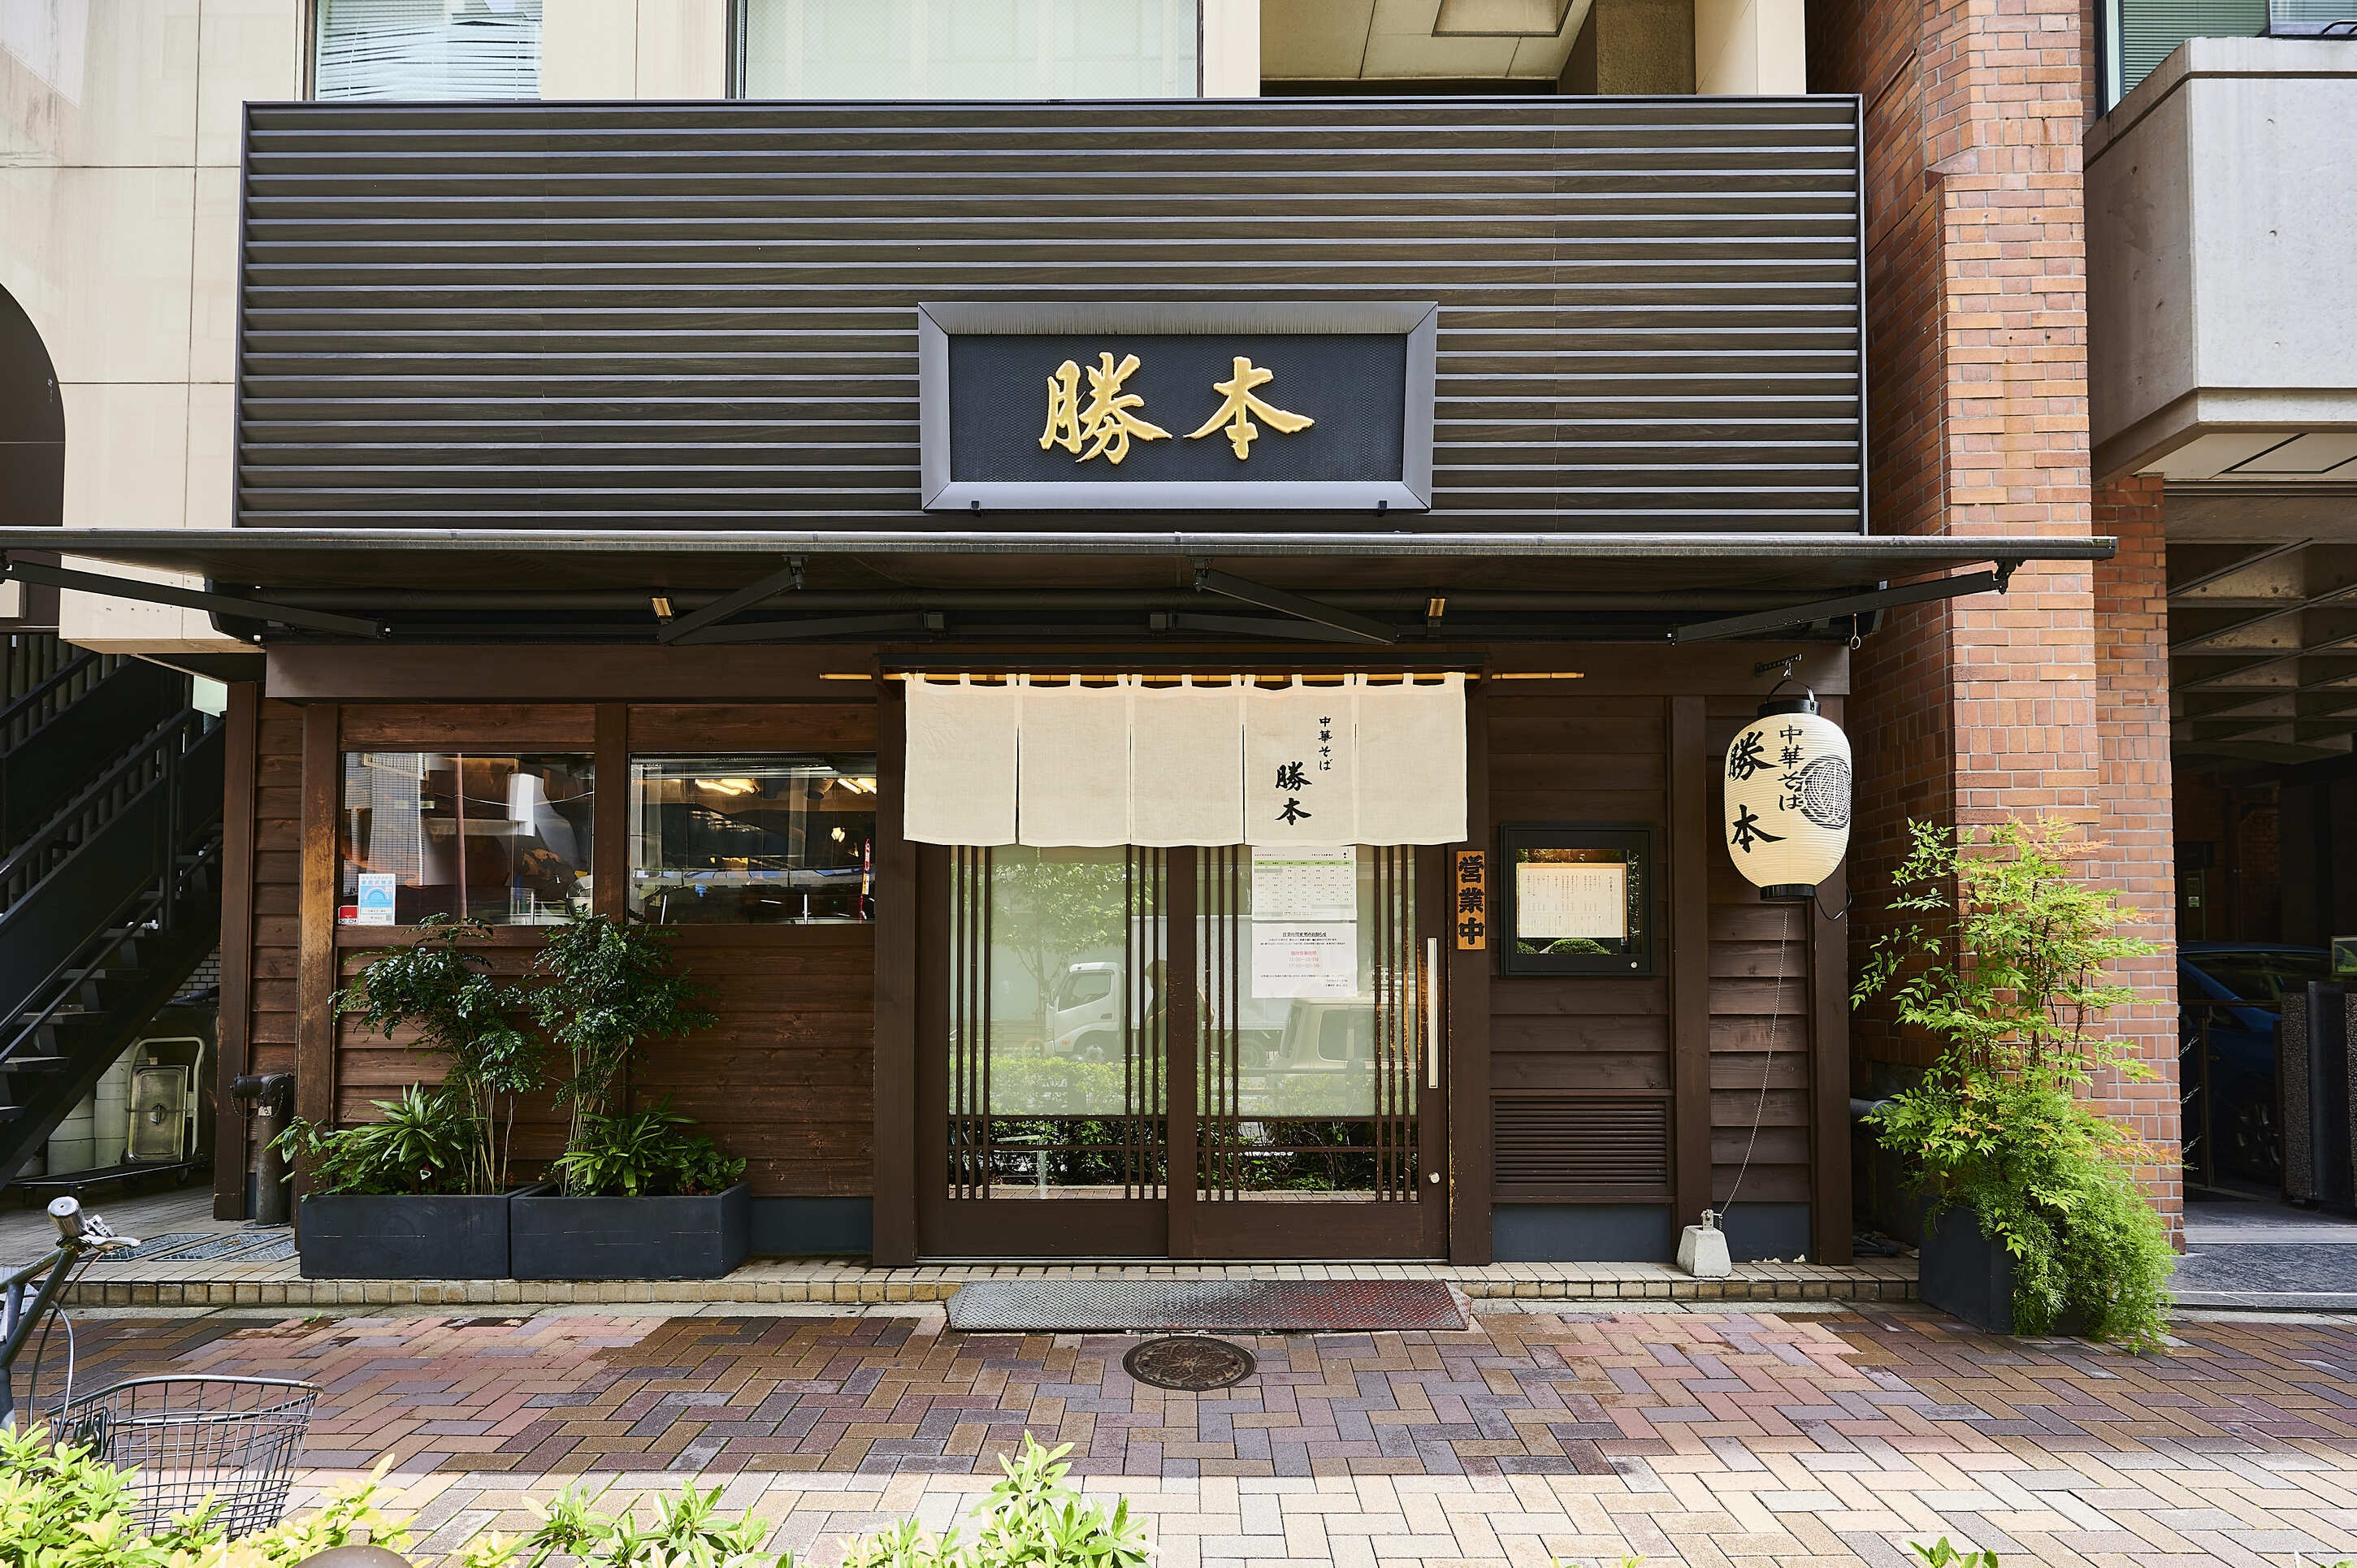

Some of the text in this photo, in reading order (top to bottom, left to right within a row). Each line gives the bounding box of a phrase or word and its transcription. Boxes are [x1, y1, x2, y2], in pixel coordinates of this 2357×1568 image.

[1038, 351, 1315, 465] 勝本
[1317, 715, 1334, 772] 中華そば
[1777, 723, 1806, 812] 中華そば
[1274, 760, 1313, 826] 勝本
[1727, 730, 1788, 854] 勝本
[1458, 854, 1485, 946] 営業中
